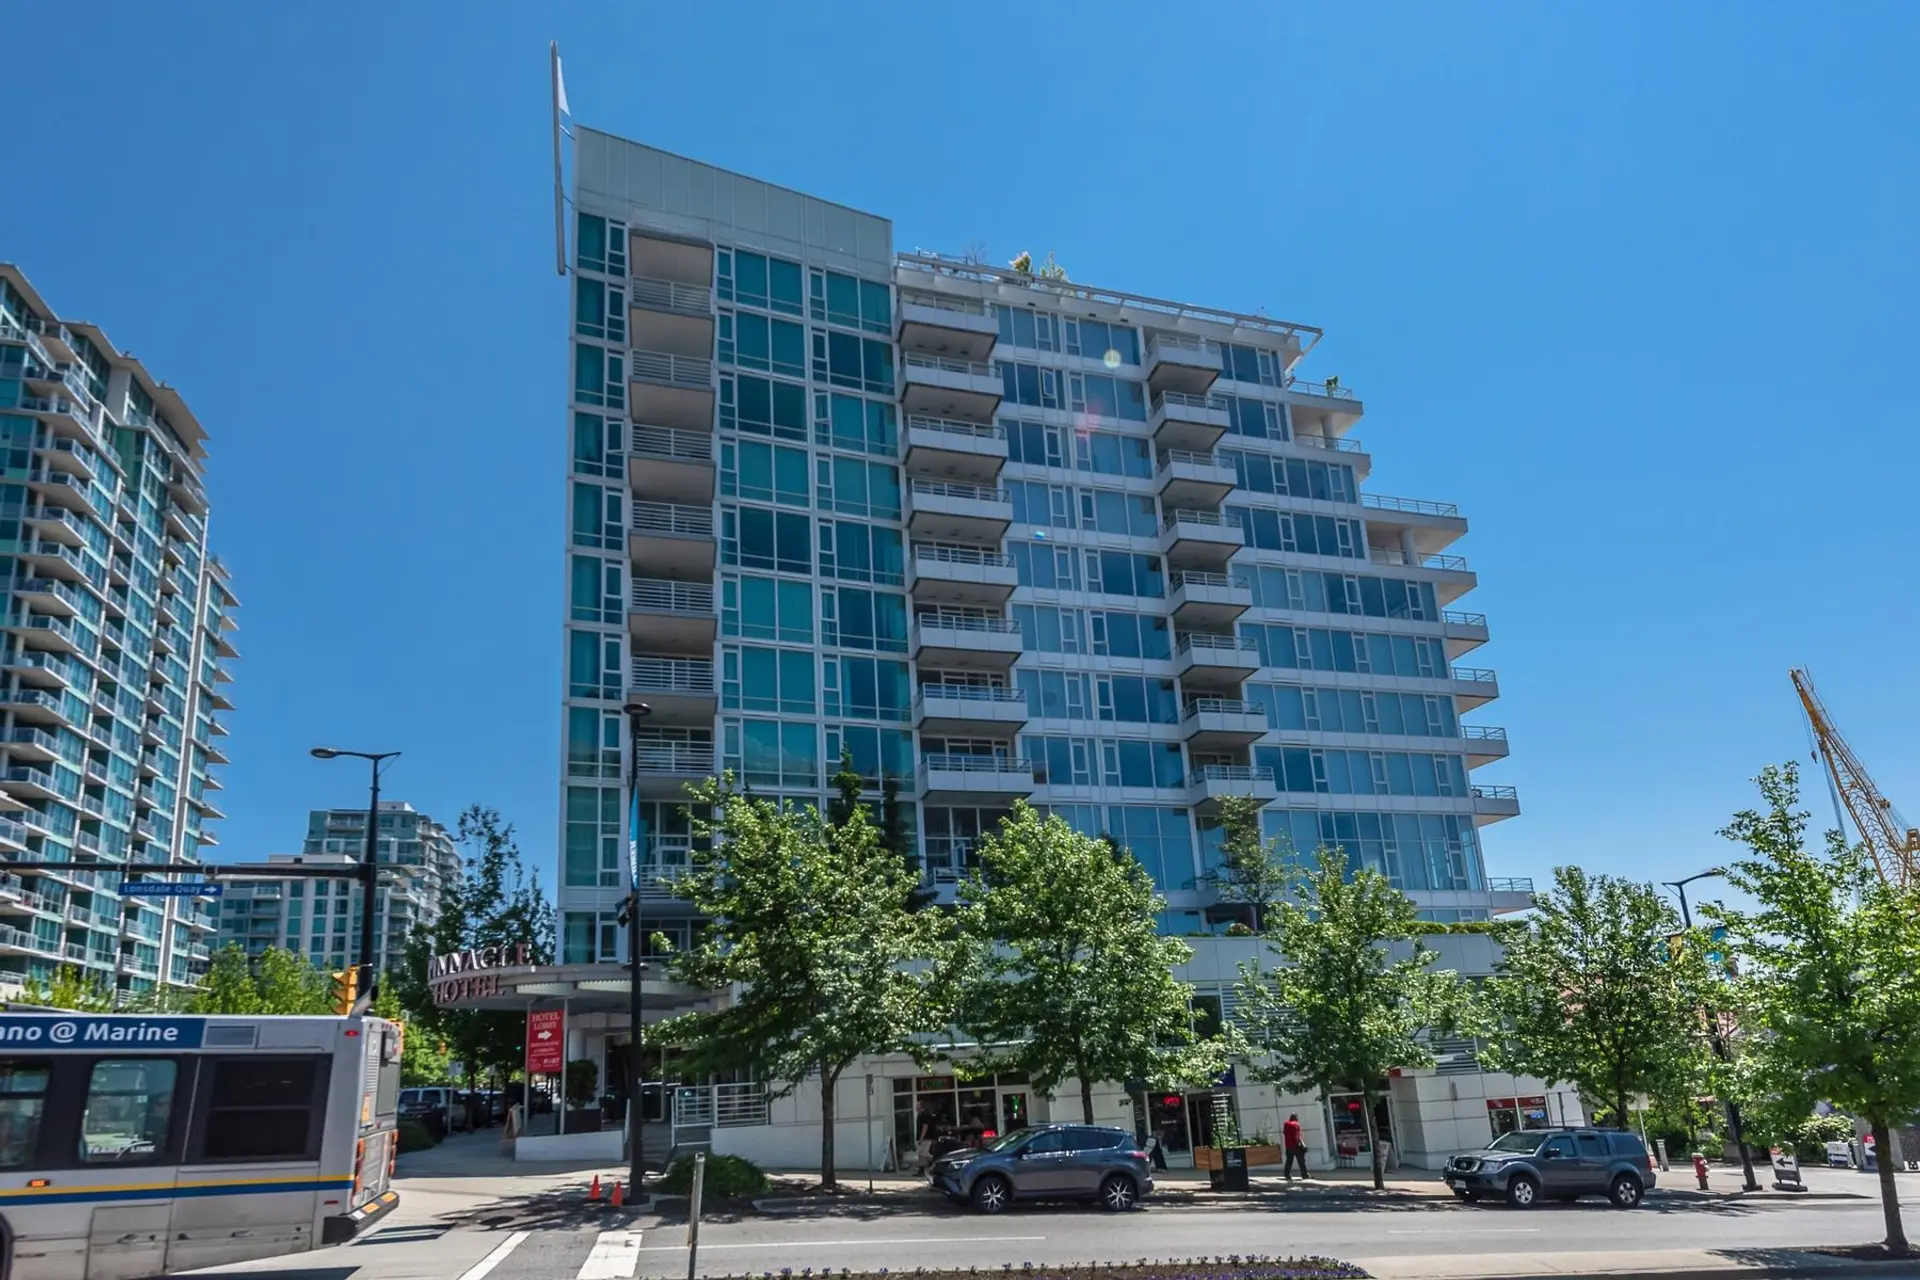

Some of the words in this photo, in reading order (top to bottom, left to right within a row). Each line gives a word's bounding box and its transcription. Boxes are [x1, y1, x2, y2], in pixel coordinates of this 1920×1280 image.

[124, 885, 171, 893] Lonsdale
[174, 885, 201, 895] Quay
[434, 974, 506, 1004] HOTEL
[531, 1012, 560, 1021] HOTEL
[50, 1021, 77, 1043] @
[84, 1022, 178, 1041] Marine
